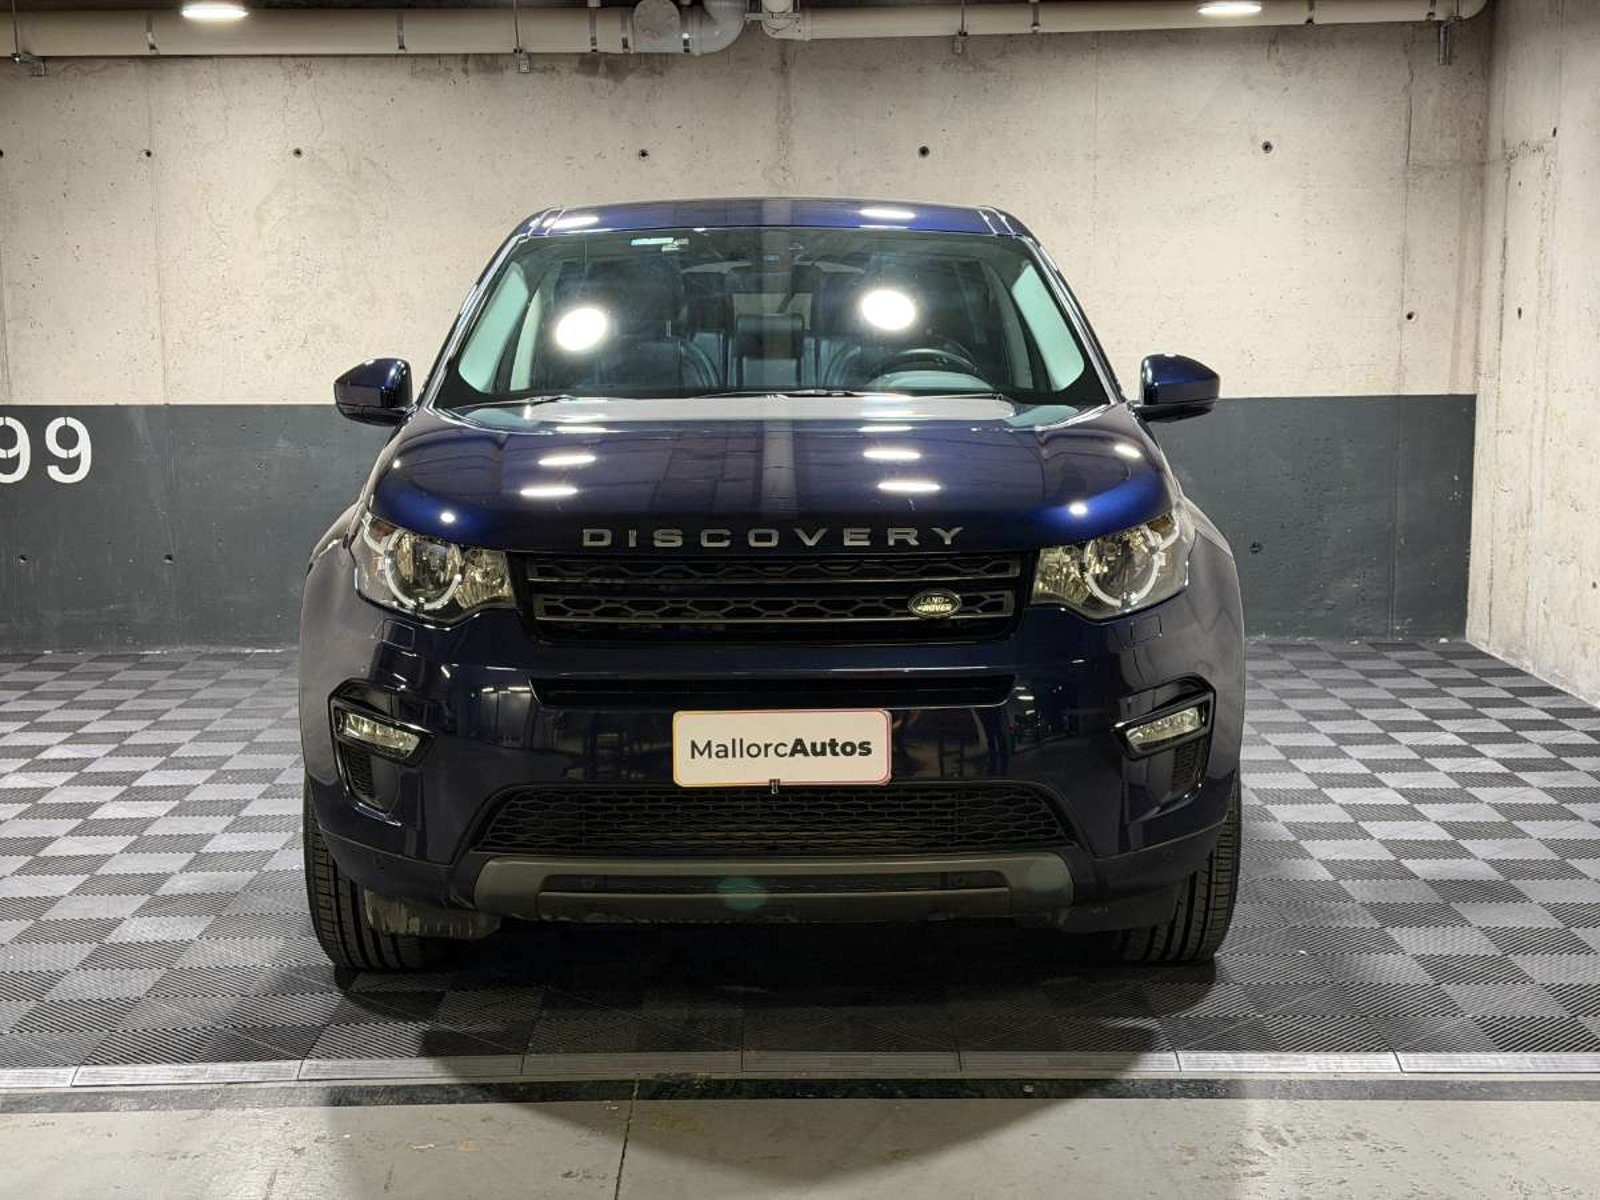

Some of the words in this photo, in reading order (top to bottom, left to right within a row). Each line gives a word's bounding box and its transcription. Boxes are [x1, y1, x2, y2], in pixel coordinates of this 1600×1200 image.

[0, 416, 92, 484] 99
[582, 527, 963, 548] DISCOVERY
[690, 738, 873, 760] MallorcAutos
